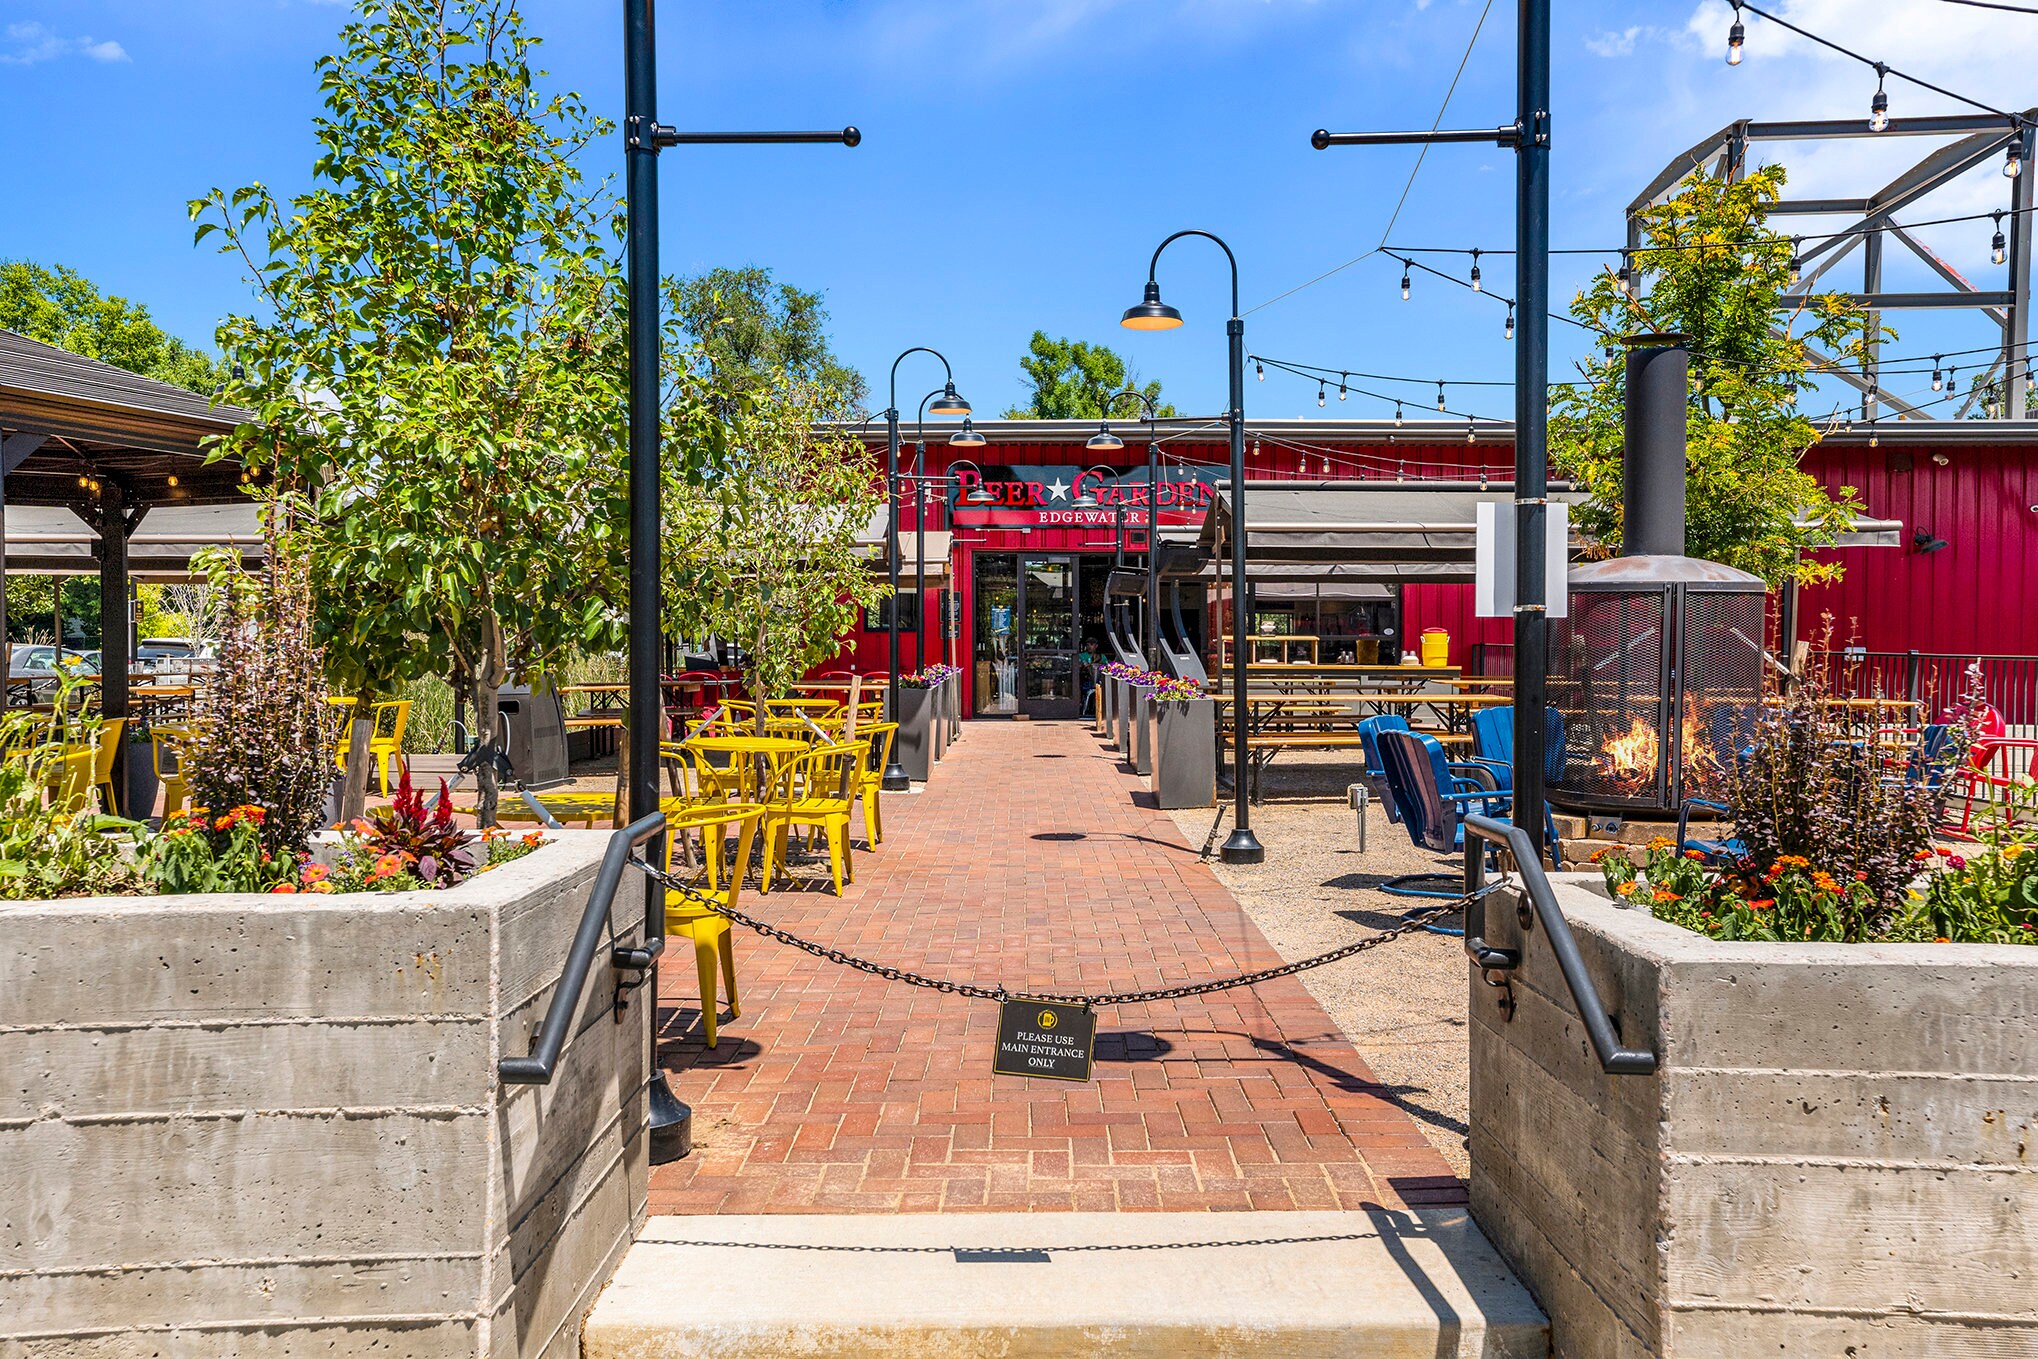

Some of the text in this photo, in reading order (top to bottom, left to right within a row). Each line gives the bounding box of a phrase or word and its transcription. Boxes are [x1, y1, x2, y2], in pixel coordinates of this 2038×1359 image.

[1039, 511, 1140, 523] EDGEWATR
[1017, 1031, 1075, 1045] PLEASE USE
[1001, 1042, 1085, 1058] MAIN ENTRANCE
[1028, 1057, 1056, 1068] ONLY
